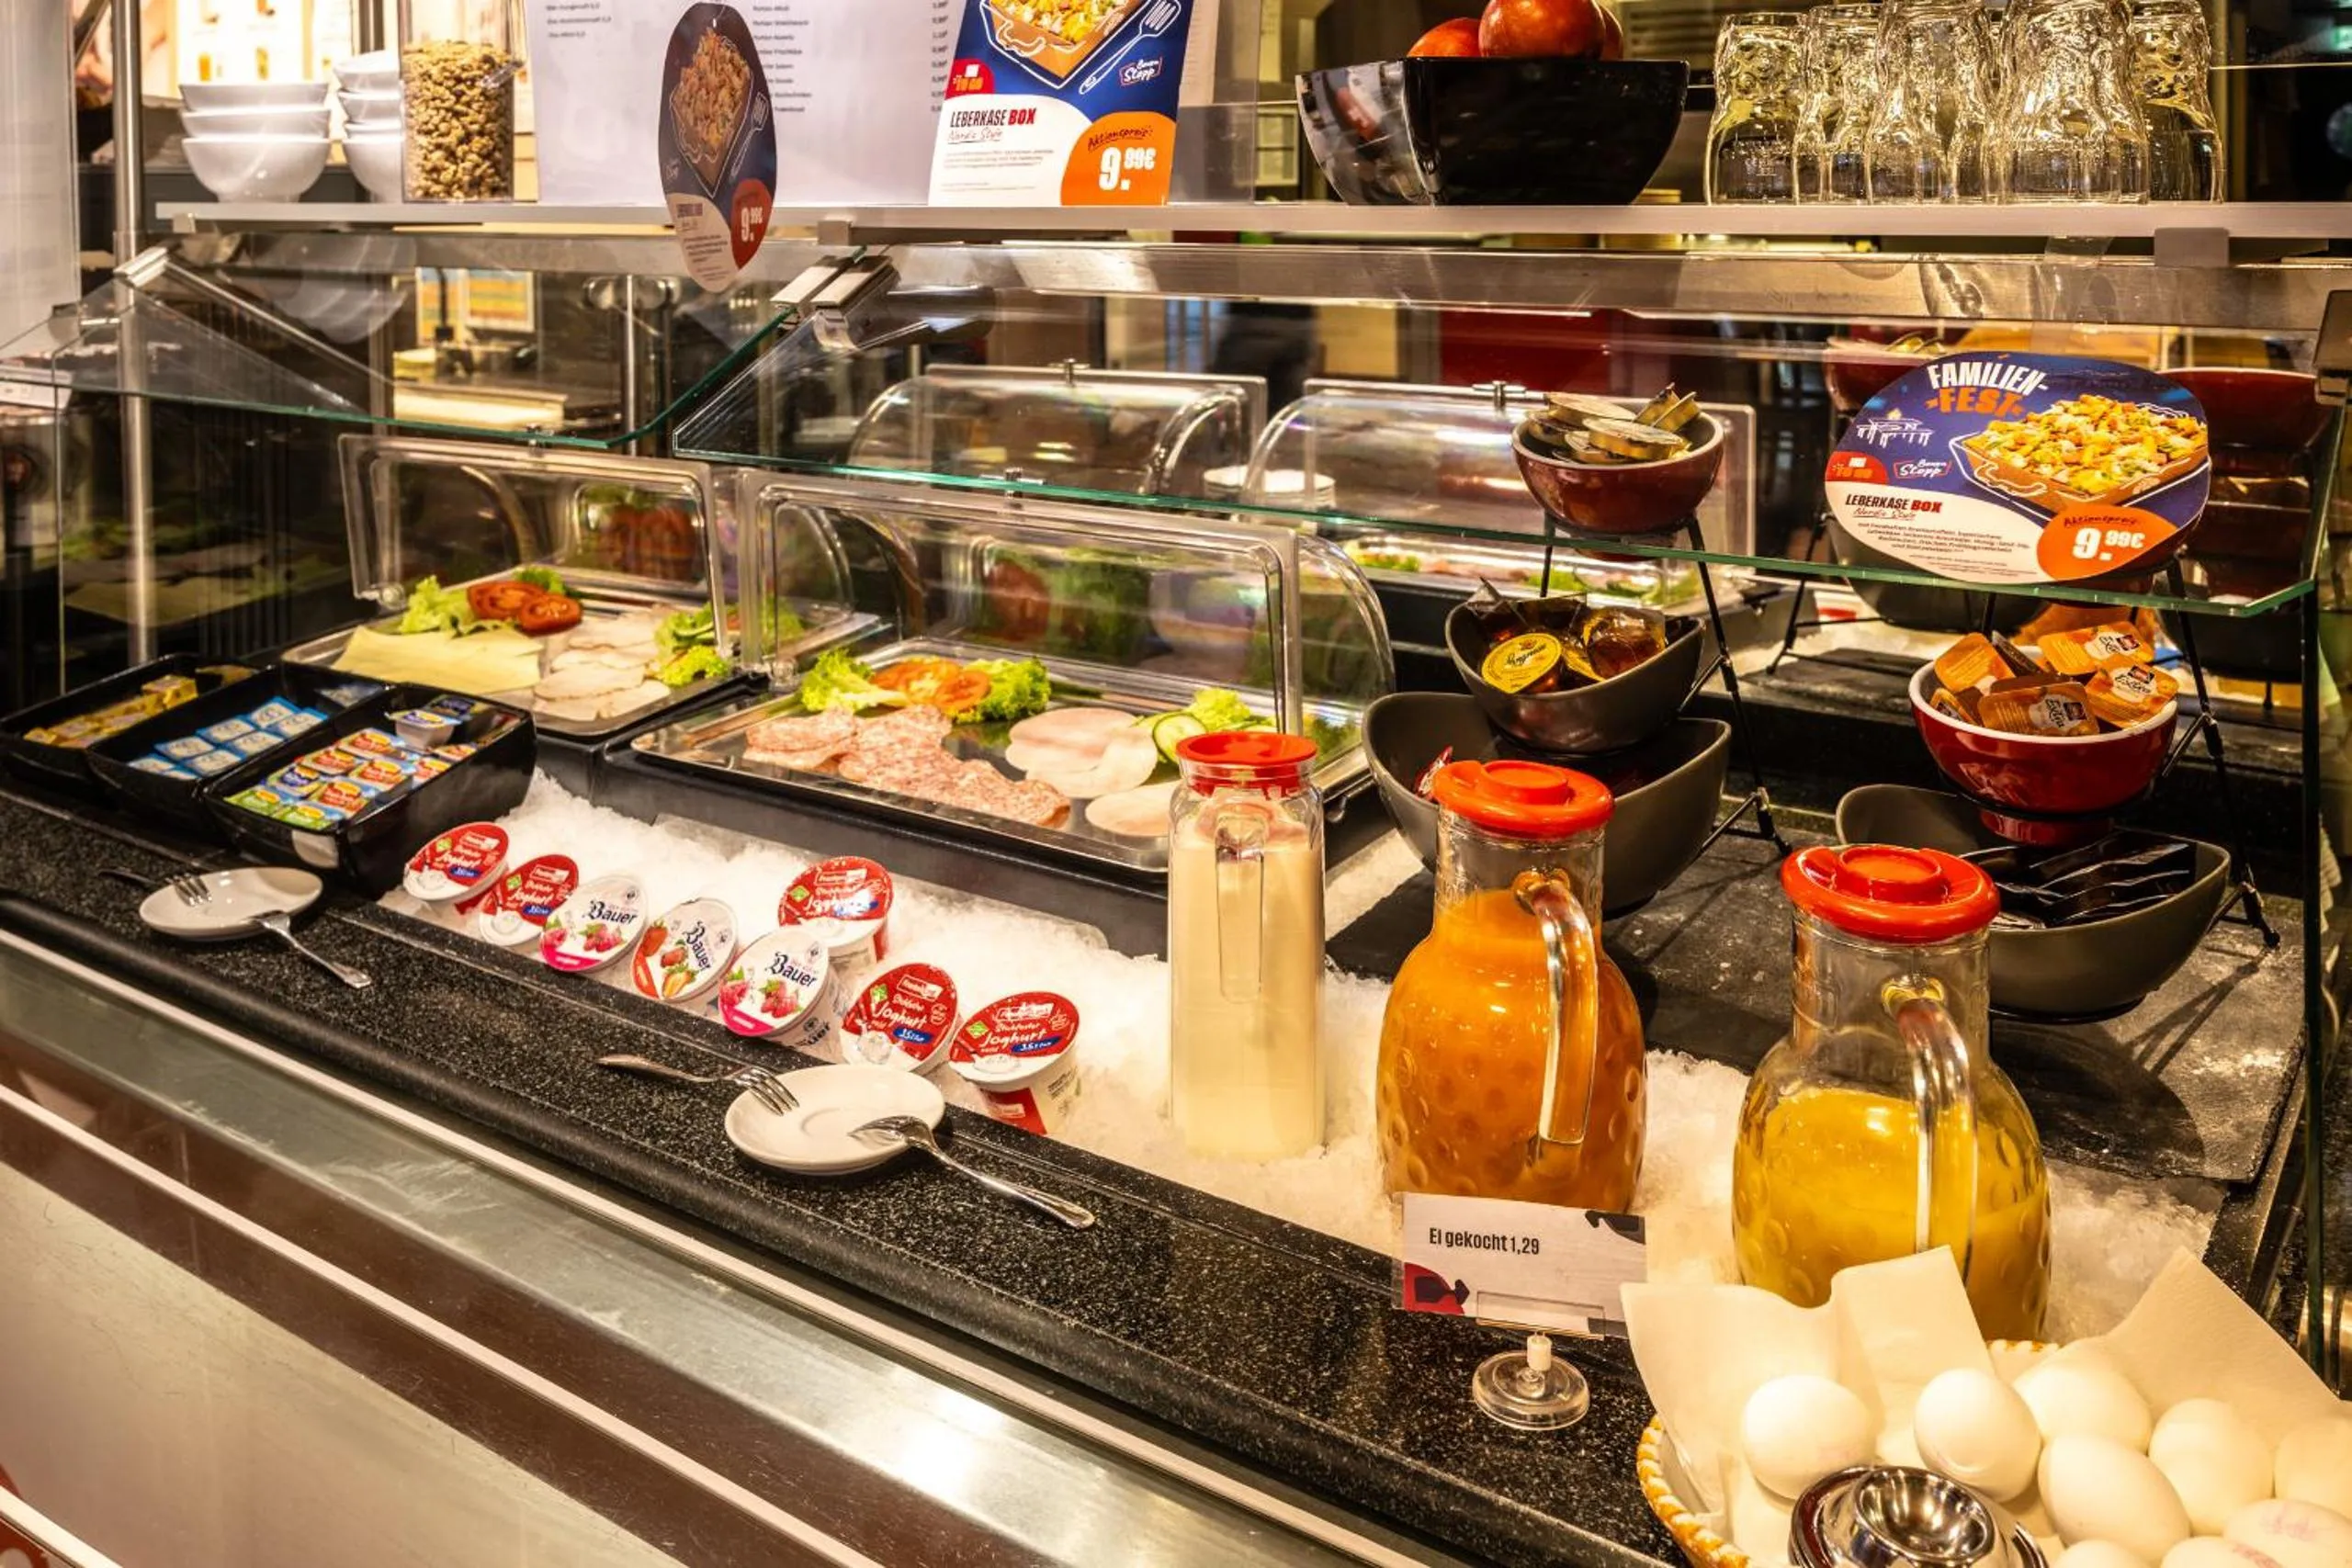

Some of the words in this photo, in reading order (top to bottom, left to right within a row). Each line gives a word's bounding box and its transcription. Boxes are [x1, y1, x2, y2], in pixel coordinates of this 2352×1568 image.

[1008, 107, 1036, 126] BOX
[1927, 361, 2049, 396] FAMILIEN-
[1911, 500, 1942, 513] BOX
[587, 900, 639, 924] Bauer
[682, 920, 712, 971] Bauer
[764, 952, 818, 987] Bauer
[872, 1001, 928, 1029] Joghurt
[979, 1028, 1046, 1049] Joghurt
[1445, 1231, 1507, 1251] gekocht
[1511, 1236, 1540, 1255] 1,29
